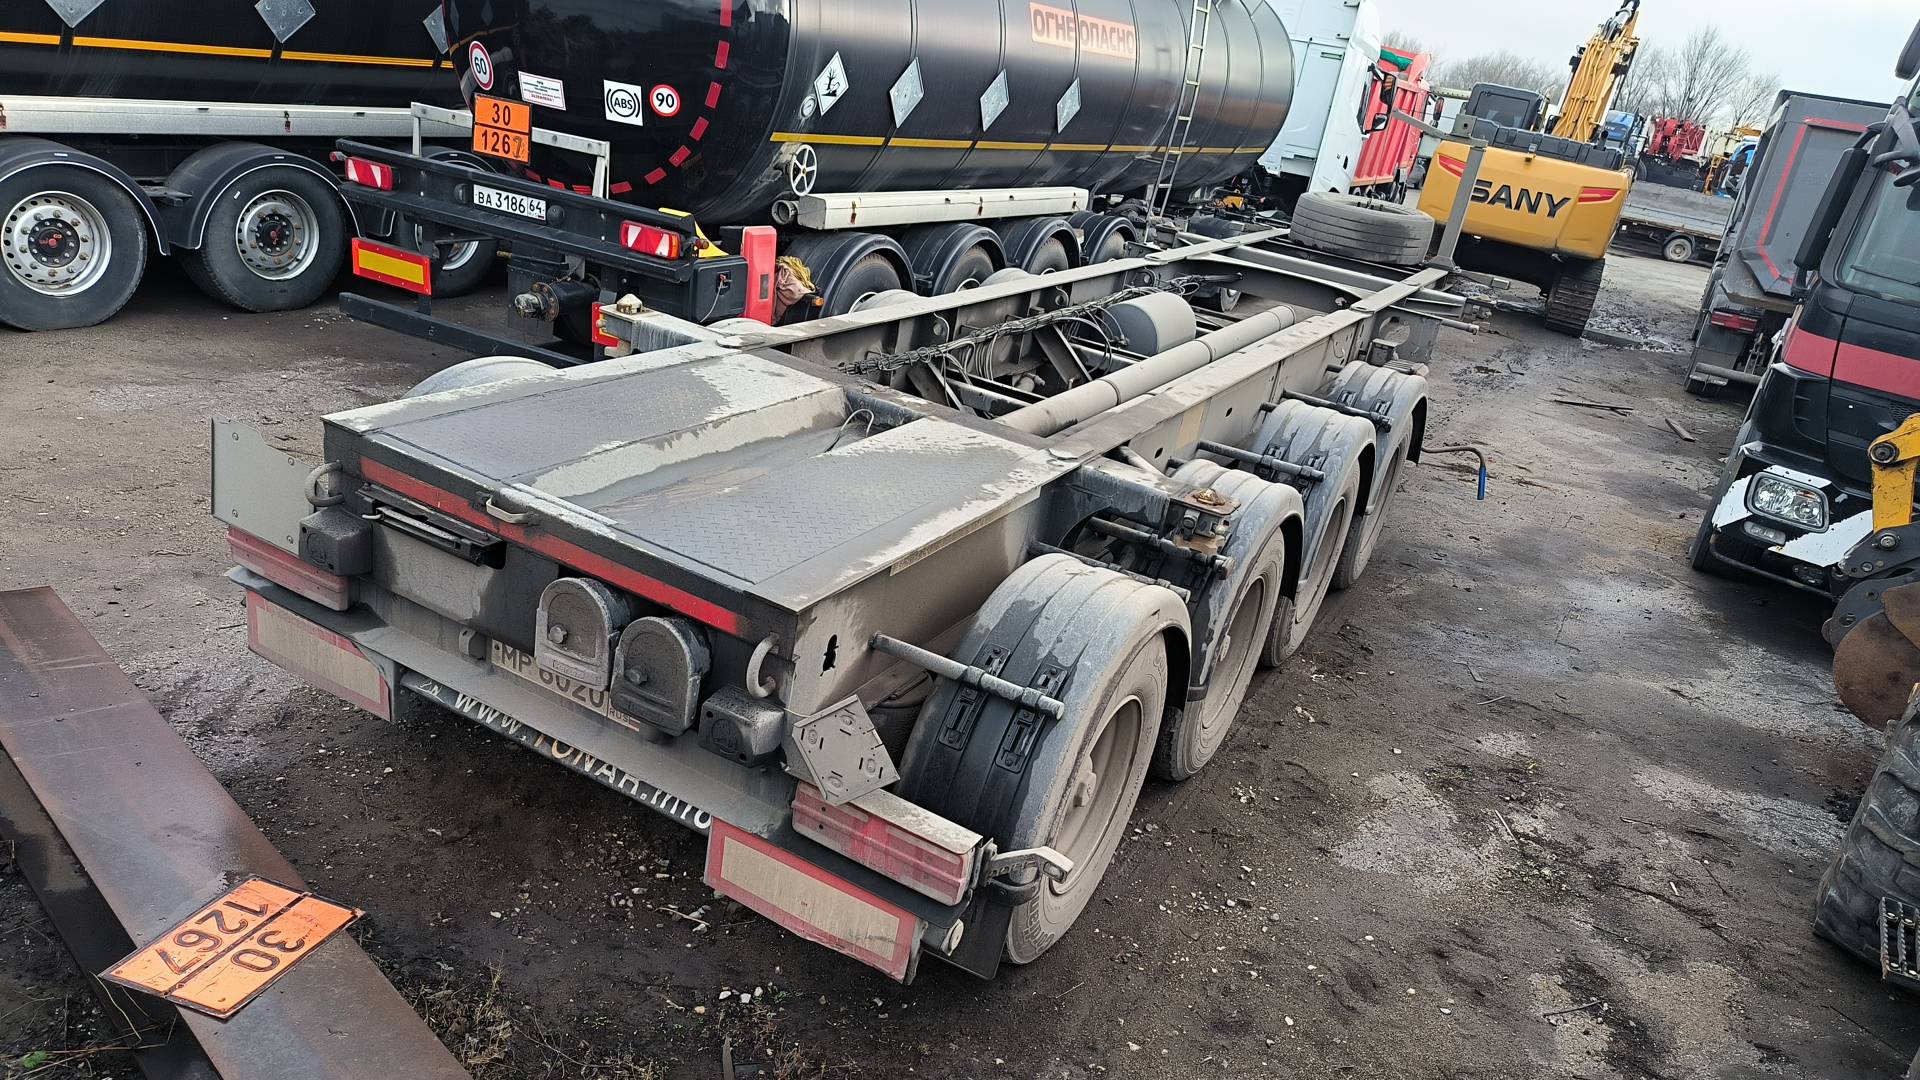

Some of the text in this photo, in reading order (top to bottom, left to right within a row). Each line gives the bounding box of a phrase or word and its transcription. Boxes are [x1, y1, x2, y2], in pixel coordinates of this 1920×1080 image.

[1032, 9, 1135, 54] ОГНЕОПАСНО
[475, 56, 487, 75] 60
[614, 97, 633, 109] ABS
[656, 92, 674, 108] 90
[492, 103, 511, 126] 30
[495, 192, 526, 214] 3186
[529, 199, 542, 214] 64
[1470, 178, 1572, 218] SANY
[155, 900, 269, 976] 1267
[230, 930, 305, 973] 30
